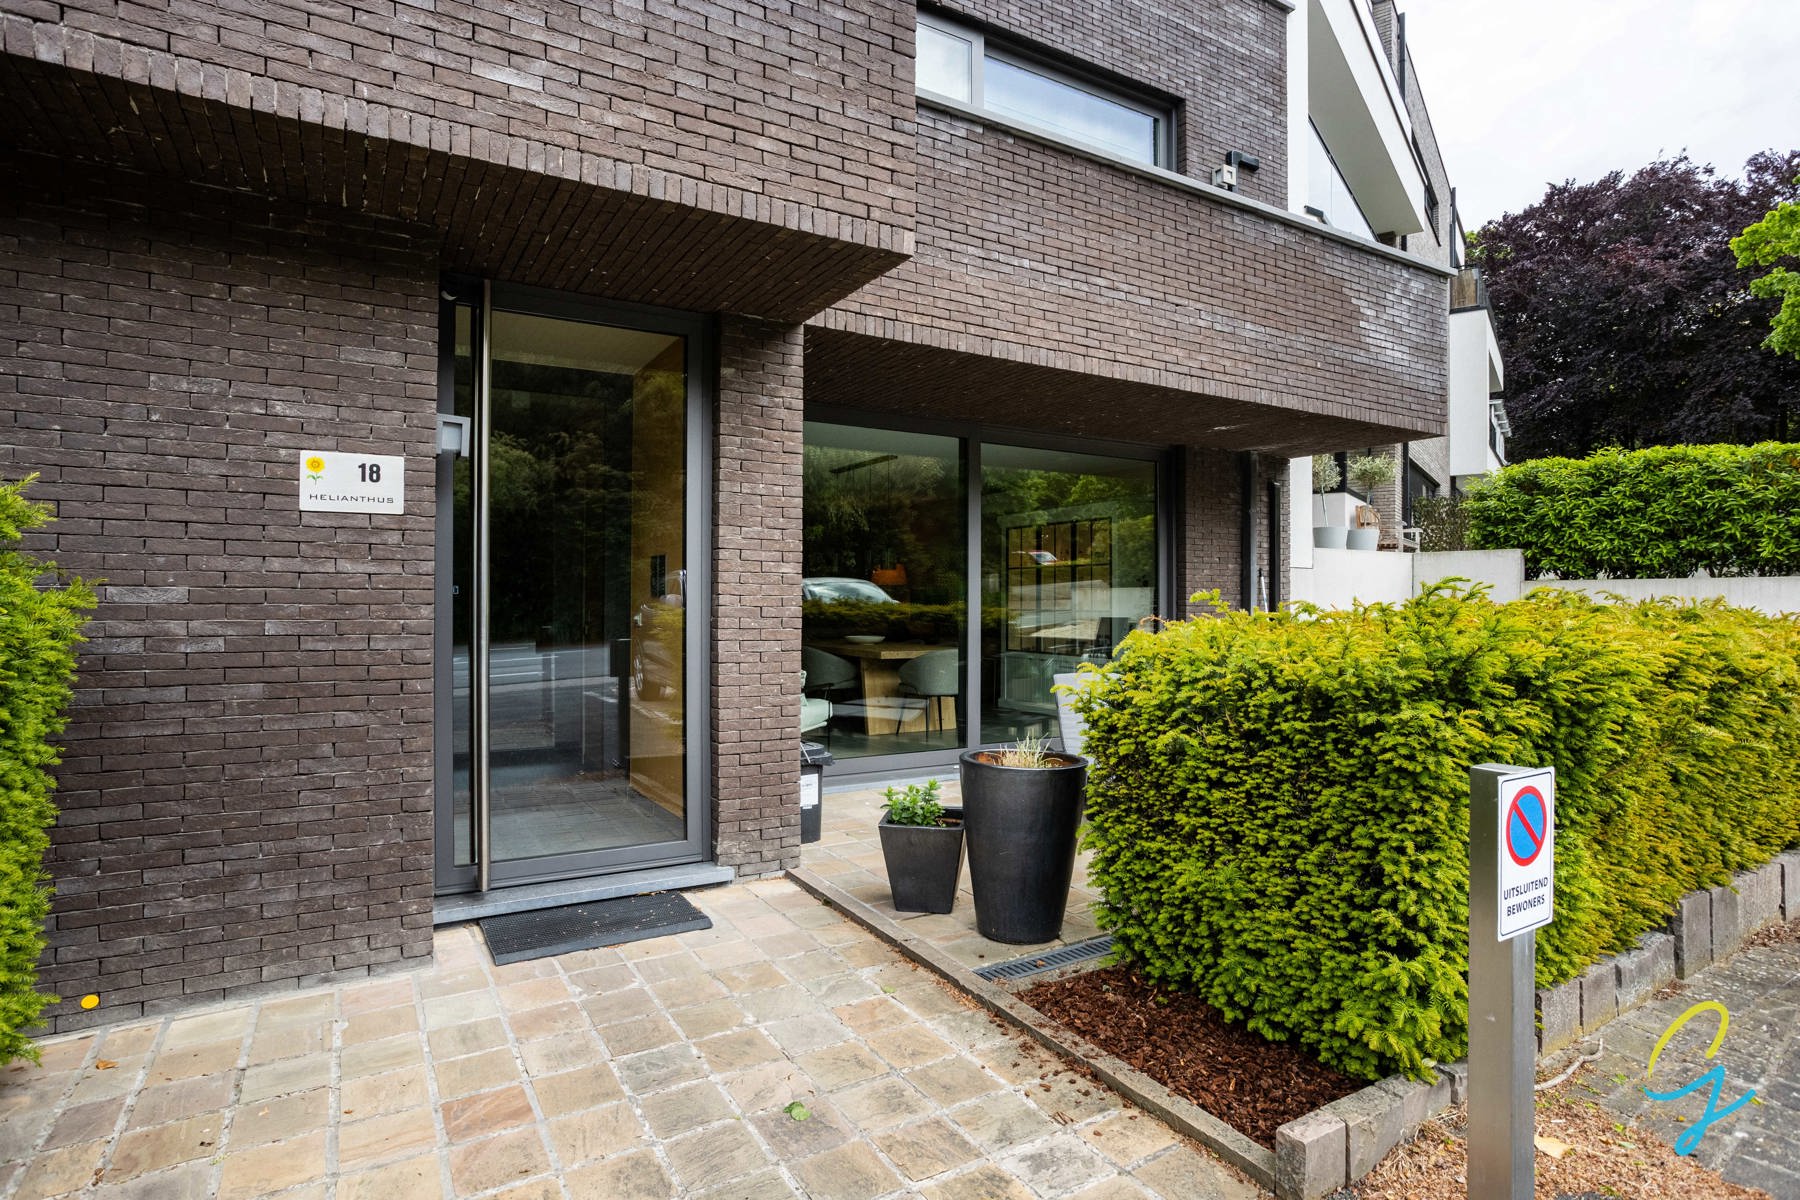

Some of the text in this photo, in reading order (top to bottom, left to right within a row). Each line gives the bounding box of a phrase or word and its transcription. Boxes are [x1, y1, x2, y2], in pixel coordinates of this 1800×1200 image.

[358, 463, 381, 483] 18
[309, 493, 394, 504] HELIANTHUS
[1503, 876, 1549, 900] UITSLUITEND
[1506, 894, 1545, 917] BEWONERS
